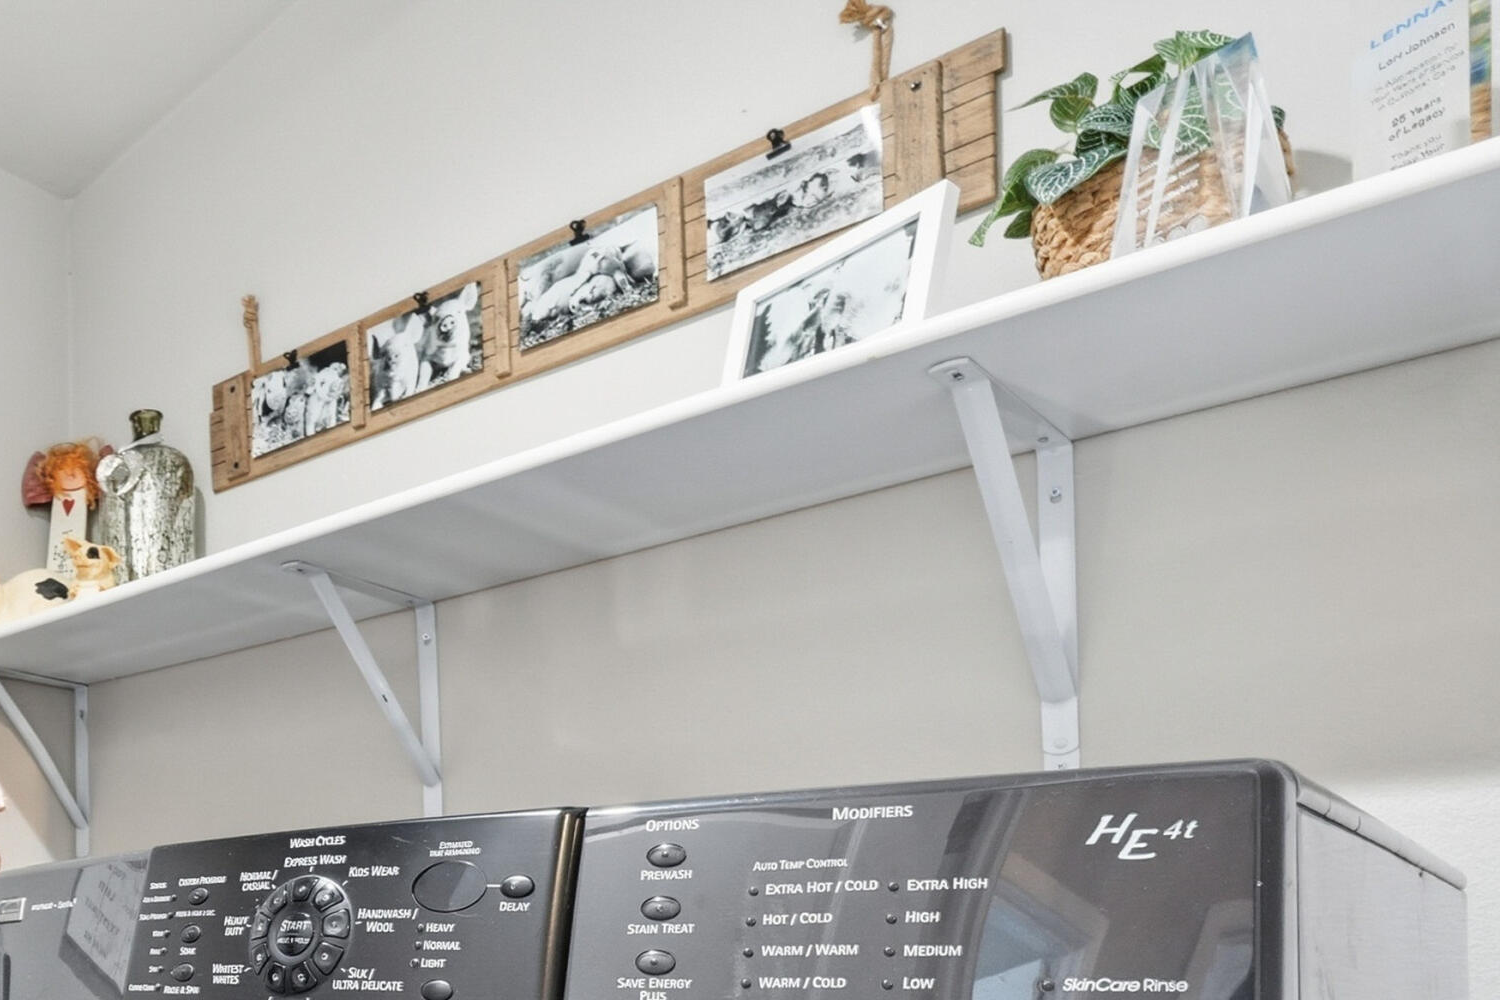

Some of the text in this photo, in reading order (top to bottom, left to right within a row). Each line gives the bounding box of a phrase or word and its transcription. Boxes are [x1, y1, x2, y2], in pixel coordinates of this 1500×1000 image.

[1370, 0, 1453, 50] LENNA
[1405, 22, 1456, 55] Johnson
[1410, 97, 1442, 116] Years
[1403, 106, 1447, 135] Legacy
[832, 805, 914, 821] MODIFIERS
[645, 819, 700, 832] OPTIONS
[315, 835, 346, 848] CYCLES
[284, 854, 347, 868] EXPRESS WASH
[753, 858, 848, 872] AUTO TEMP CONTROL
[371, 865, 400, 876] WEAR
[640, 869, 693, 881] PREWASH
[765, 883, 803, 895] EXTRA
[807, 881, 833, 893] HOT
[844, 879, 879, 891] COLD
[907, 877, 988, 891] EXTRA HIGH
[499, 902, 531, 912] DELAY
[357, 908, 412, 920] HANDWASH
[762, 914, 789, 925] HOT
[799, 912, 833, 924] COLD
[905, 910, 941, 924] HIGH
[280, 920, 311, 932] START
[366, 922, 395, 933] WOOL
[425, 923, 456, 933] HEAVY
[627, 923, 695, 935] STAIN TREAT
[423, 941, 461, 951] NORMAL
[761, 944, 804, 957] WARM
[815, 943, 859, 956] WARM
[903, 944, 963, 957] MEDIUM
[420, 958, 447, 968] LIGHT
[332, 980, 404, 992] ULTRA DELICATE
[617, 977, 693, 989] SAVE ENERGY
[759, 976, 800, 989] WARM
[812, 976, 847, 989] COLD
[902, 976, 935, 990] LOW
[1062, 977, 1189, 993] SkinCare Rinse
